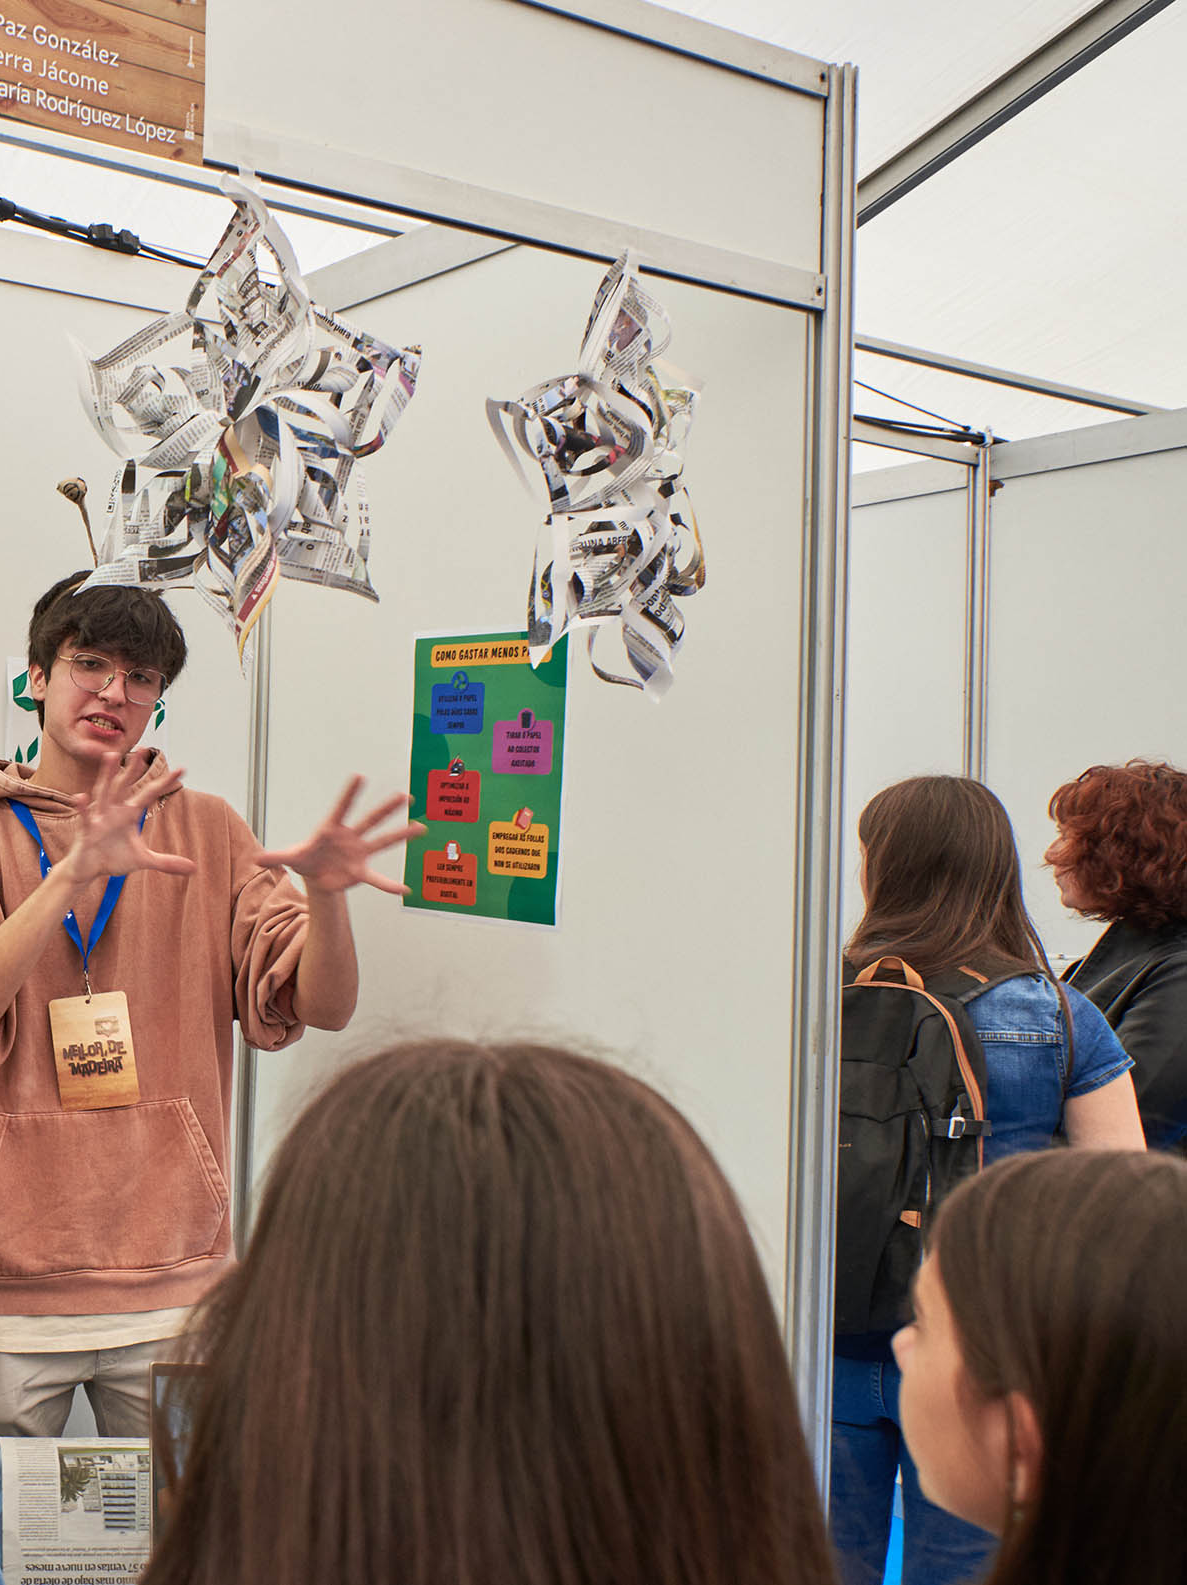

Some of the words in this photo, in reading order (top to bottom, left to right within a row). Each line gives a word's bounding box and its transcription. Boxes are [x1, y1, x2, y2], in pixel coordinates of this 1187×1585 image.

[33, 26, 120, 67] González
[38, 57, 109, 95] Jácome
[35, 89, 121, 131] Rodríguez
[125, 115, 176, 145] López
[435, 649, 456, 662] COMO
[459, 647, 489, 661] GASTAR
[491, 646, 519, 659] MENOS
[108, 1040, 127, 1055] DE
[69, 1056, 124, 1077] MADEIRA
[25, 1563, 54, 1572] meses
[55, 1564, 83, 1572] nueve
[84, 1564, 96, 1572] en
[97, 1563, 127, 1573] ventas
